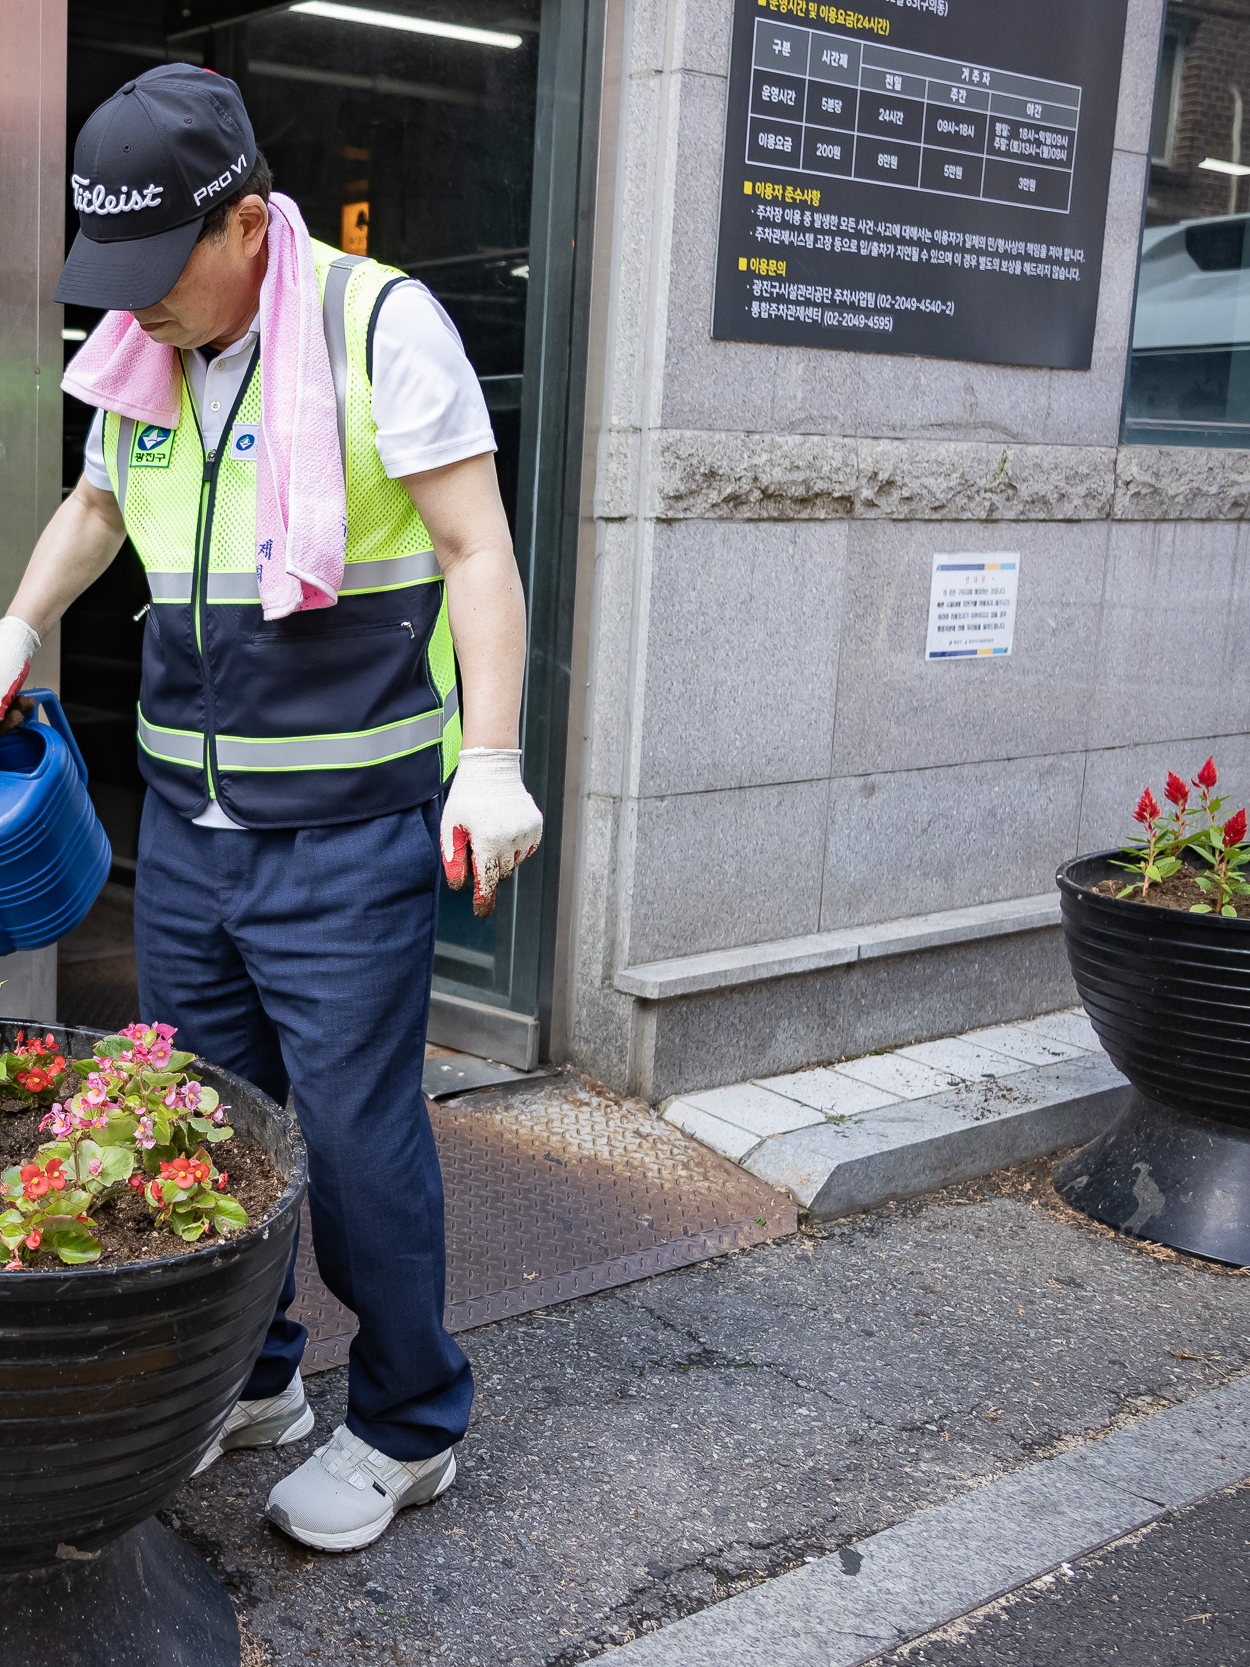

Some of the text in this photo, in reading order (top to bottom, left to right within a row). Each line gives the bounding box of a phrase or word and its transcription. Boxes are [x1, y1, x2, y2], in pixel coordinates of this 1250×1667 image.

[808, 4, 818, 20] 및
[819, 6, 890, 36] 이용요금(24시간)
[772, 38, 848, 69] 구분 시간제
[761, 84, 975, 139] 운영시간 5분당 24시간 09시~18시
[884, 73, 1043, 118] 전일 주간 야간
[758, 132, 1037, 193] 이용요금 200원 8만원 5만원 3만원
[71, 173, 164, 216] Titleist
[193, 170, 233, 207] PRO
[755, 181, 822, 207] 이용자 준수사항
[756, 204, 783, 224] 주차장
[784, 208, 802, 225] 이용
[803, 210, 812, 227] 중
[813, 212, 839, 230] 발생한
[839, 216, 857, 233] 모든
[901, 224, 933, 244] 대해서는
[933, 229, 964, 249] 이용자가
[1026, 242, 1048, 261] 책임을
[749, 256, 787, 277] 이용문의
[754, 226, 815, 249] 주차관제시스템
[815, 234, 833, 252] 고장
[833, 236, 858, 254] 등으로
[859, 239, 895, 259] 입/출차가
[920, 247, 929, 264] 수
[930, 248, 953, 267] 있으며
[953, 252, 962, 268] 이
[963, 253, 979, 270] 경우
[978, 255, 1001, 273] 별도의
[1000, 258, 1023, 276] 보상을
[1022, 261, 1052, 279] 해드리지
[750, 300, 894, 332] 통합주차관제센터 (02-2049-4595)
[752, 278, 955, 317] 광진구시설관리공단 주차사업팀 (02-2049-4540~2)
[134, 452, 166, 463] 광진구
